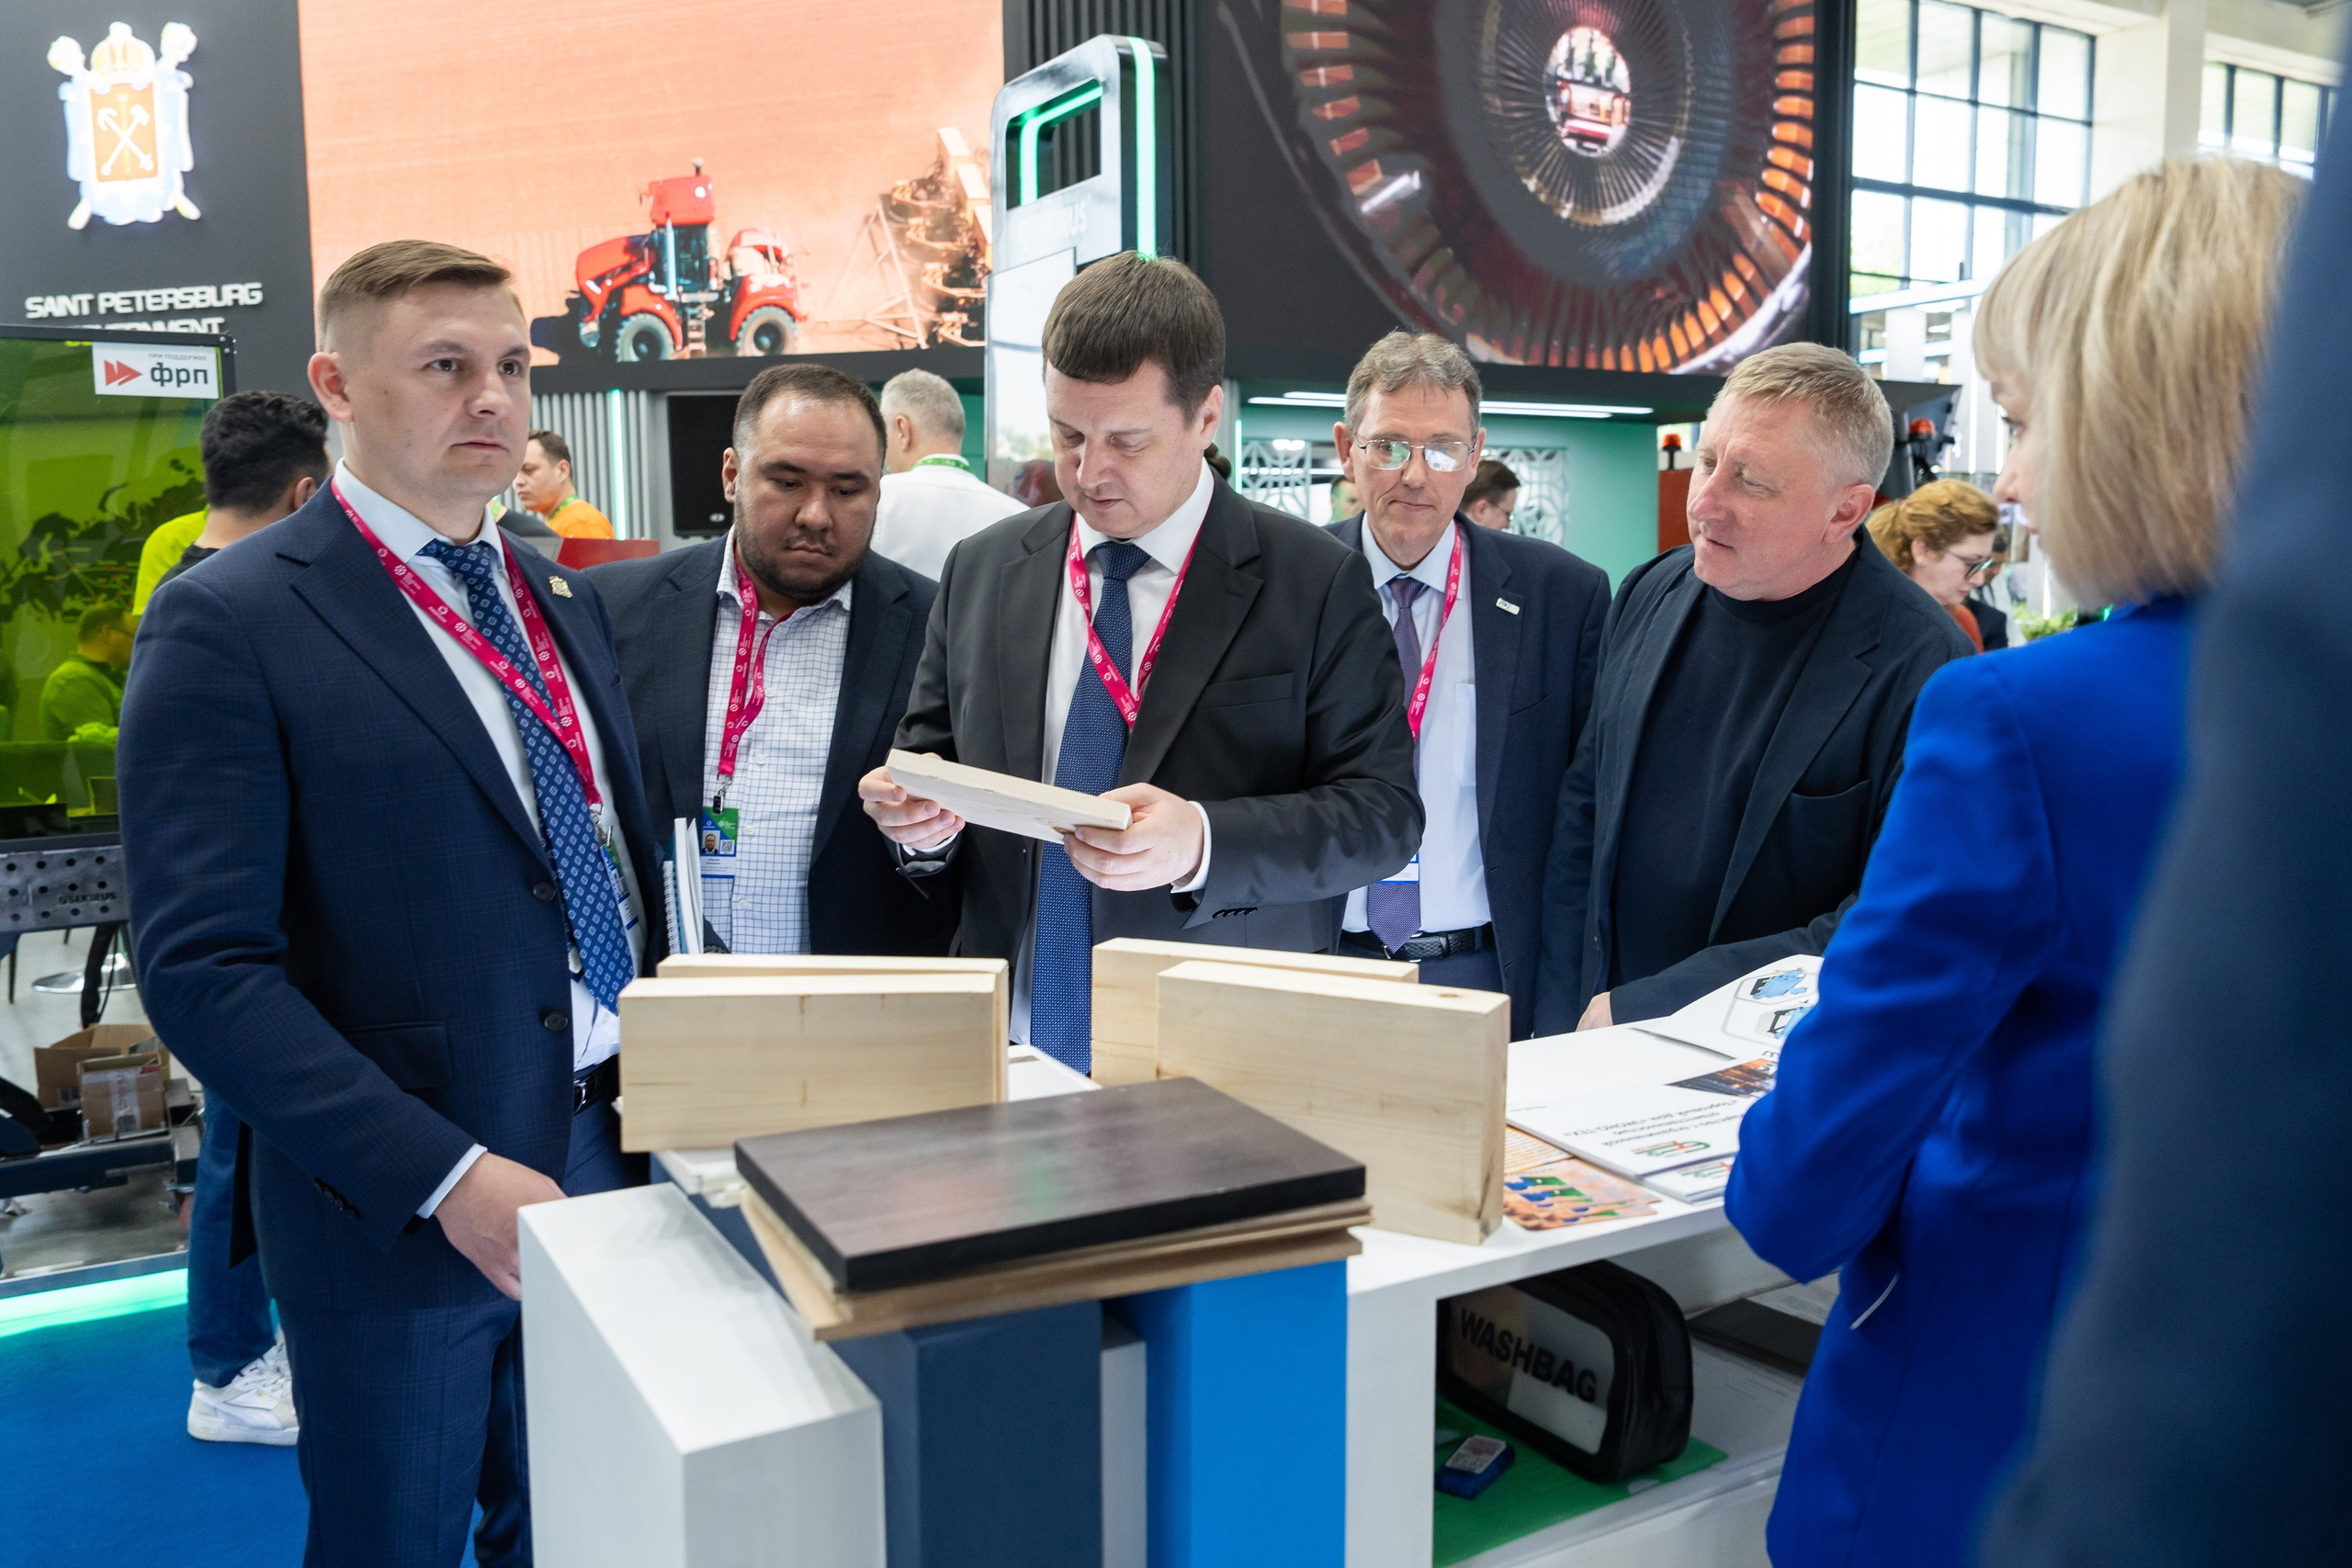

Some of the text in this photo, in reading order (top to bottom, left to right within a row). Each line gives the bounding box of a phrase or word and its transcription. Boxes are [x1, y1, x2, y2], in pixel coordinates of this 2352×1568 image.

[25, 282, 264, 319] SAINT PETERSBURG
[151, 362, 208, 388] фрп
[1460, 1307, 1597, 1404] WASHBAG
